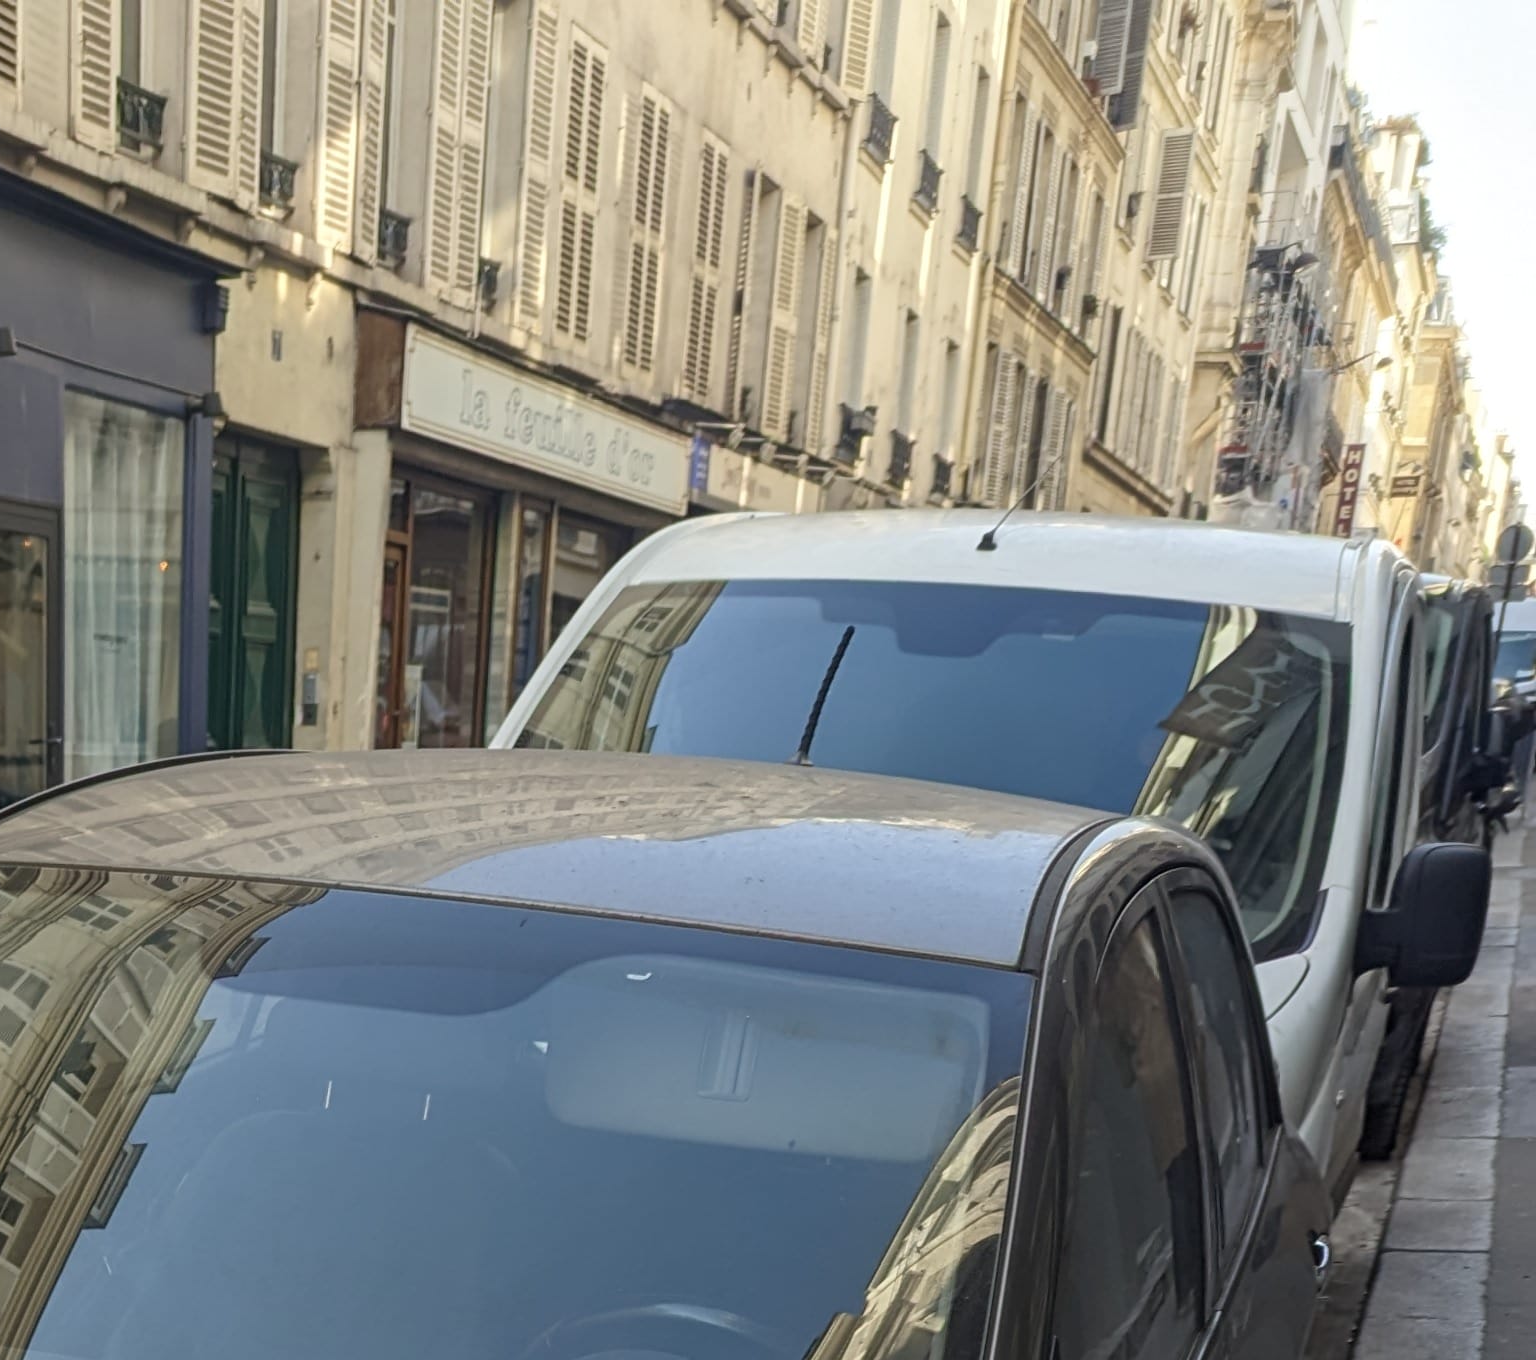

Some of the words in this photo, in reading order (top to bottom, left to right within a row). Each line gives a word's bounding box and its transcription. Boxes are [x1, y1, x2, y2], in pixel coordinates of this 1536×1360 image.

[460, 368, 491, 431] la
[504, 387, 597, 468] feuille
[607, 426, 655, 487] d'or
[1337, 450, 1362, 536] HOTEL
